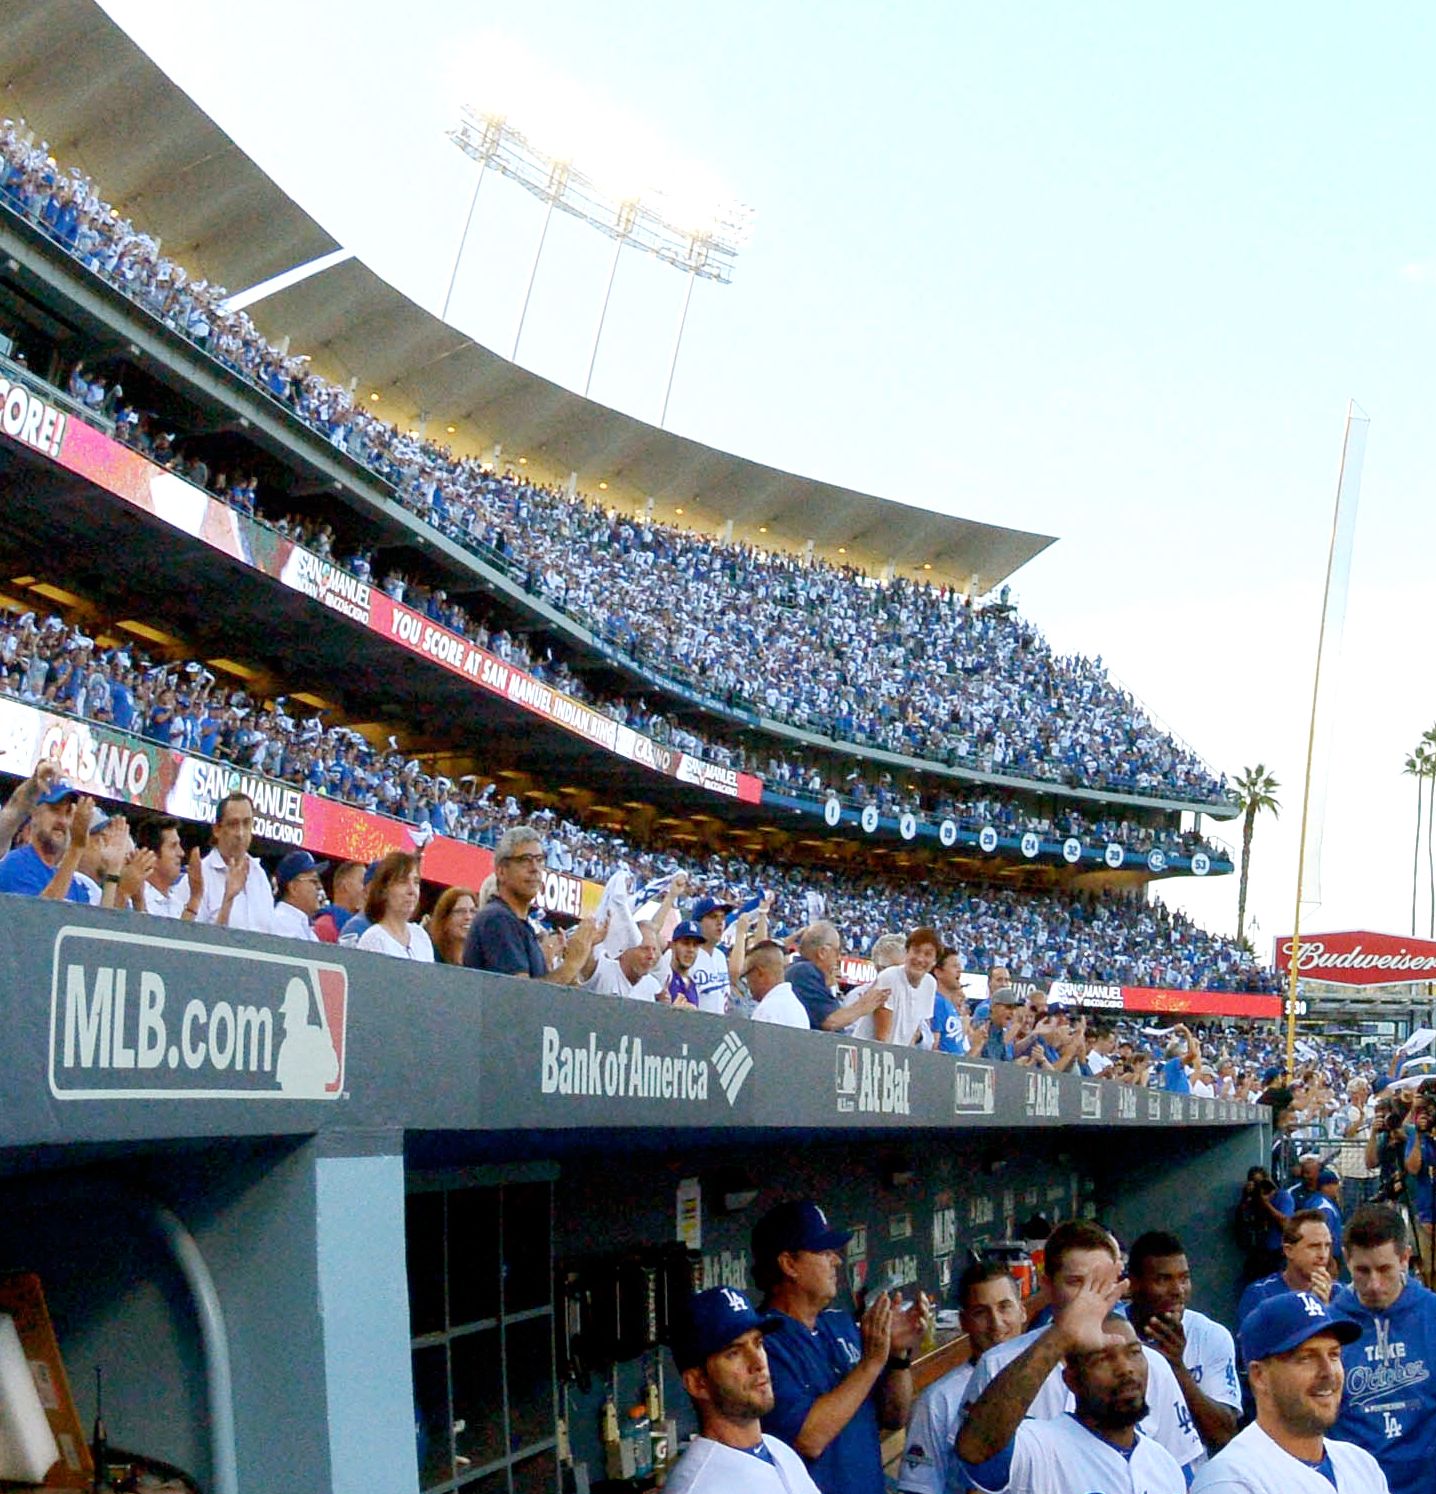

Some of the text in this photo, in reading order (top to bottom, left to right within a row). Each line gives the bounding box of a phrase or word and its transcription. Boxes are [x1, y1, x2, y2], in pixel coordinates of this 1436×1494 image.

[329, 567, 372, 611] MANUEL
[391, 608, 422, 645] YOU
[423, 626, 465, 668] SCORE
[464, 650, 482, 677] AT
[481, 656, 509, 692] SAN
[508, 673, 552, 713] MANUEL
[552, 696, 590, 732] INDIAN
[39, 725, 149, 796] CASINO
[193, 763, 304, 824] SAN MANUEL
[63, 964, 273, 1071] MLB.com
[1084, 985, 1124, 999] MANUEL
[541, 1025, 708, 1101] Bank of America
[858, 1047, 910, 1115] At Bat
[721, 1288, 748, 1312] LA
[1297, 1292, 1326, 1317] LA
[1347, 1359, 1430, 1394] October
[1383, 1411, 1402, 1439] LA
